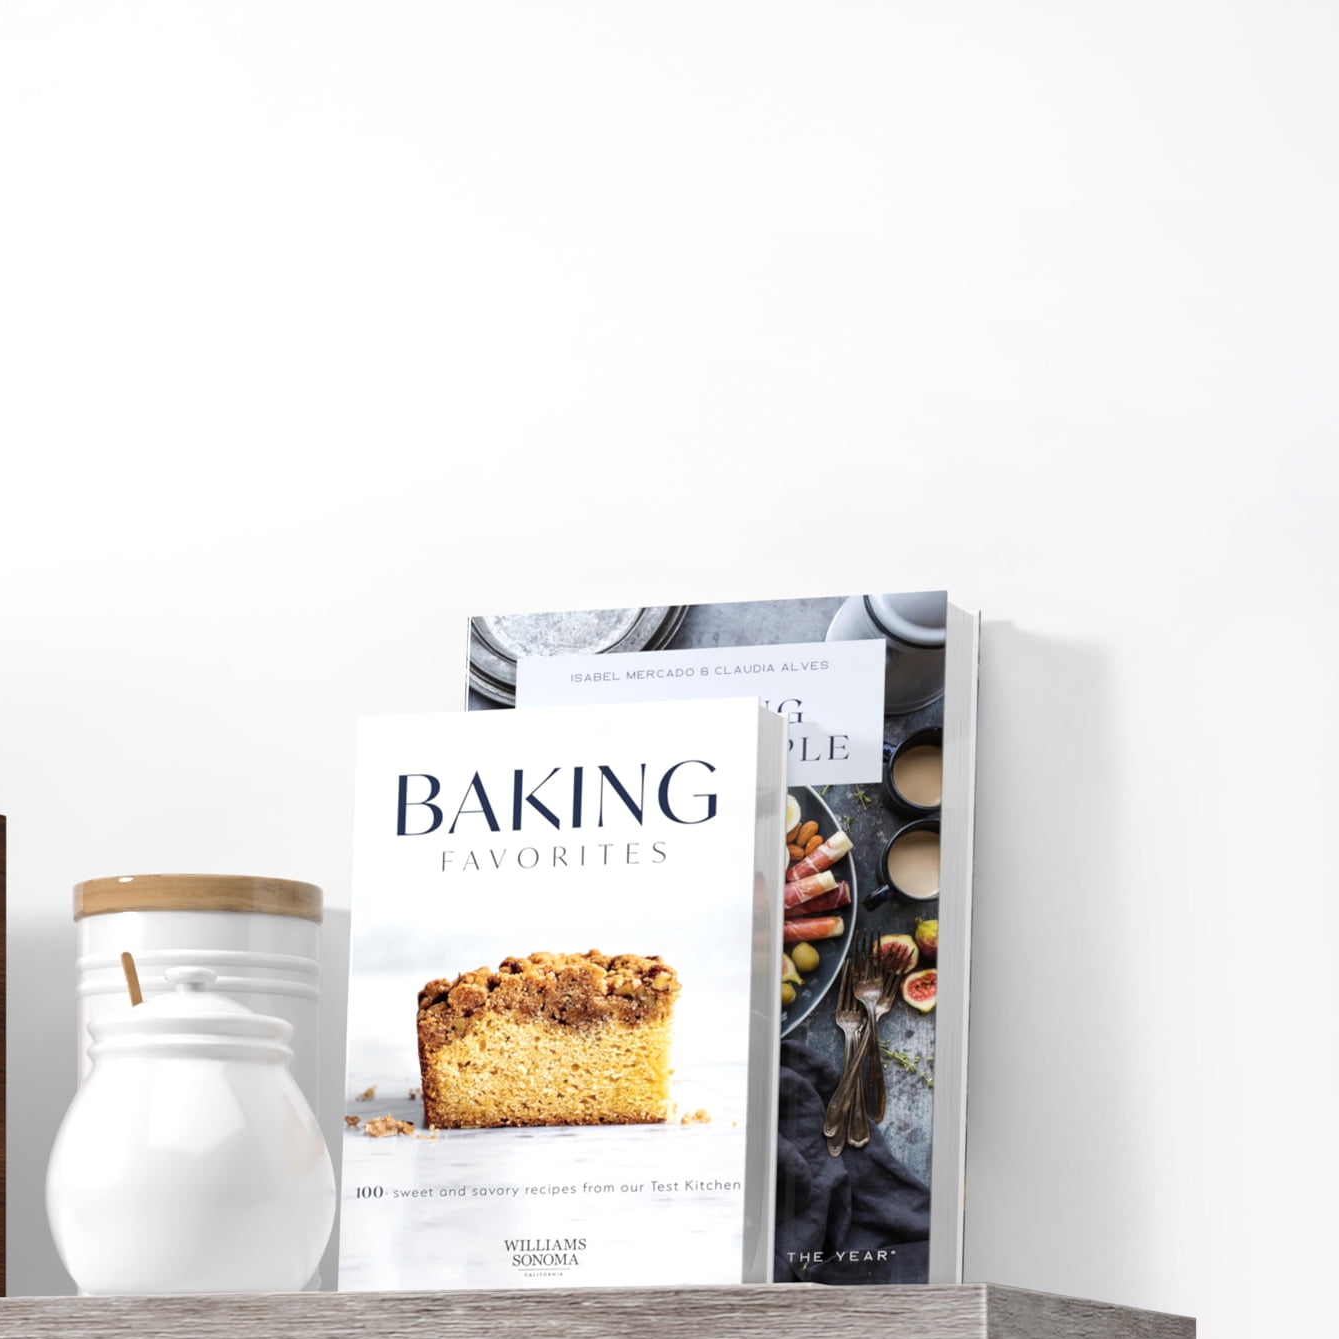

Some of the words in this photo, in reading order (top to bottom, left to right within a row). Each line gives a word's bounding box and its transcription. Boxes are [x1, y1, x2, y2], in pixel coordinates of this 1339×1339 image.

[571, 671, 621, 683] ISABEL
[625, 667, 695, 680] MERCADO
[714, 663, 775, 676] CLAUDIA
[781, 660, 829, 672] ALVES
[396, 760, 718, 836] BAKING
[441, 841, 667, 872] FAVORITES
[393, 1187, 434, 1198] sweet
[439, 1186, 467, 1197] and
[472, 1186, 520, 1198] savory
[525, 1182, 576, 1196] recipes
[583, 1182, 615, 1193] from
[621, 1182, 644, 1192] our
[651, 1180, 679, 1192] Test
[685, 1179, 741, 1191] Kitchen
[504, 1238, 587, 1252] WILLIAMS
[512, 1253, 580, 1267] SONOMA
[786, 1251, 824, 1262] THE
